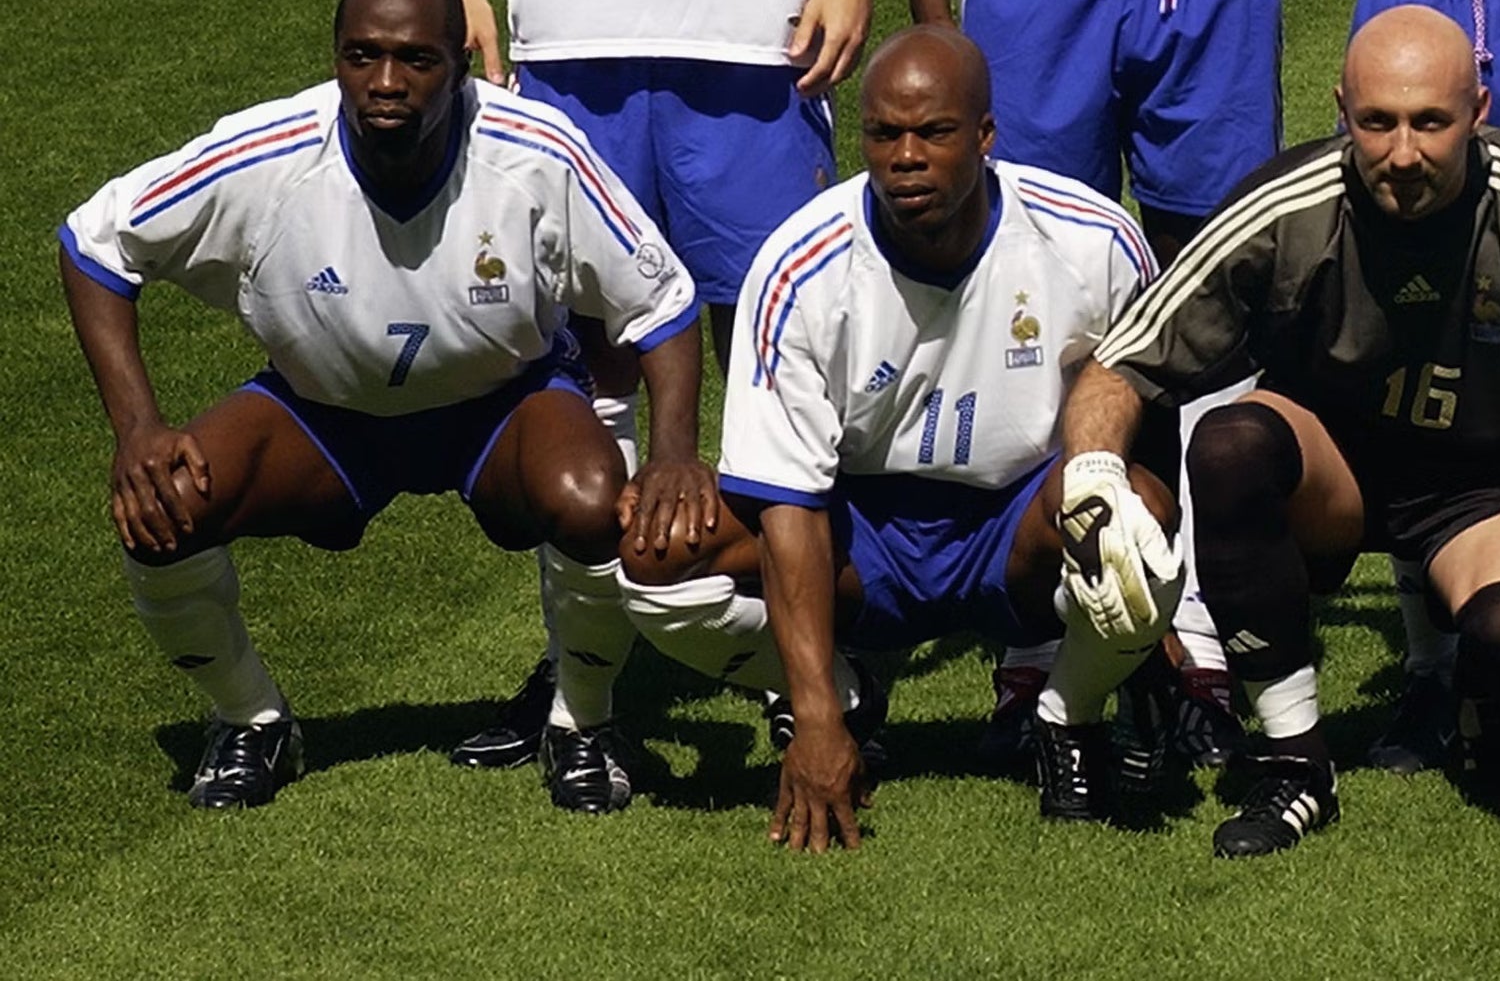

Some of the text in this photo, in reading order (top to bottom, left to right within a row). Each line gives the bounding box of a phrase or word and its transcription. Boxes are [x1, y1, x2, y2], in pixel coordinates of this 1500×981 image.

[386, 322, 431, 388] 7
[917, 386, 978, 466] 11
[1380, 362, 1462, 430] 16
